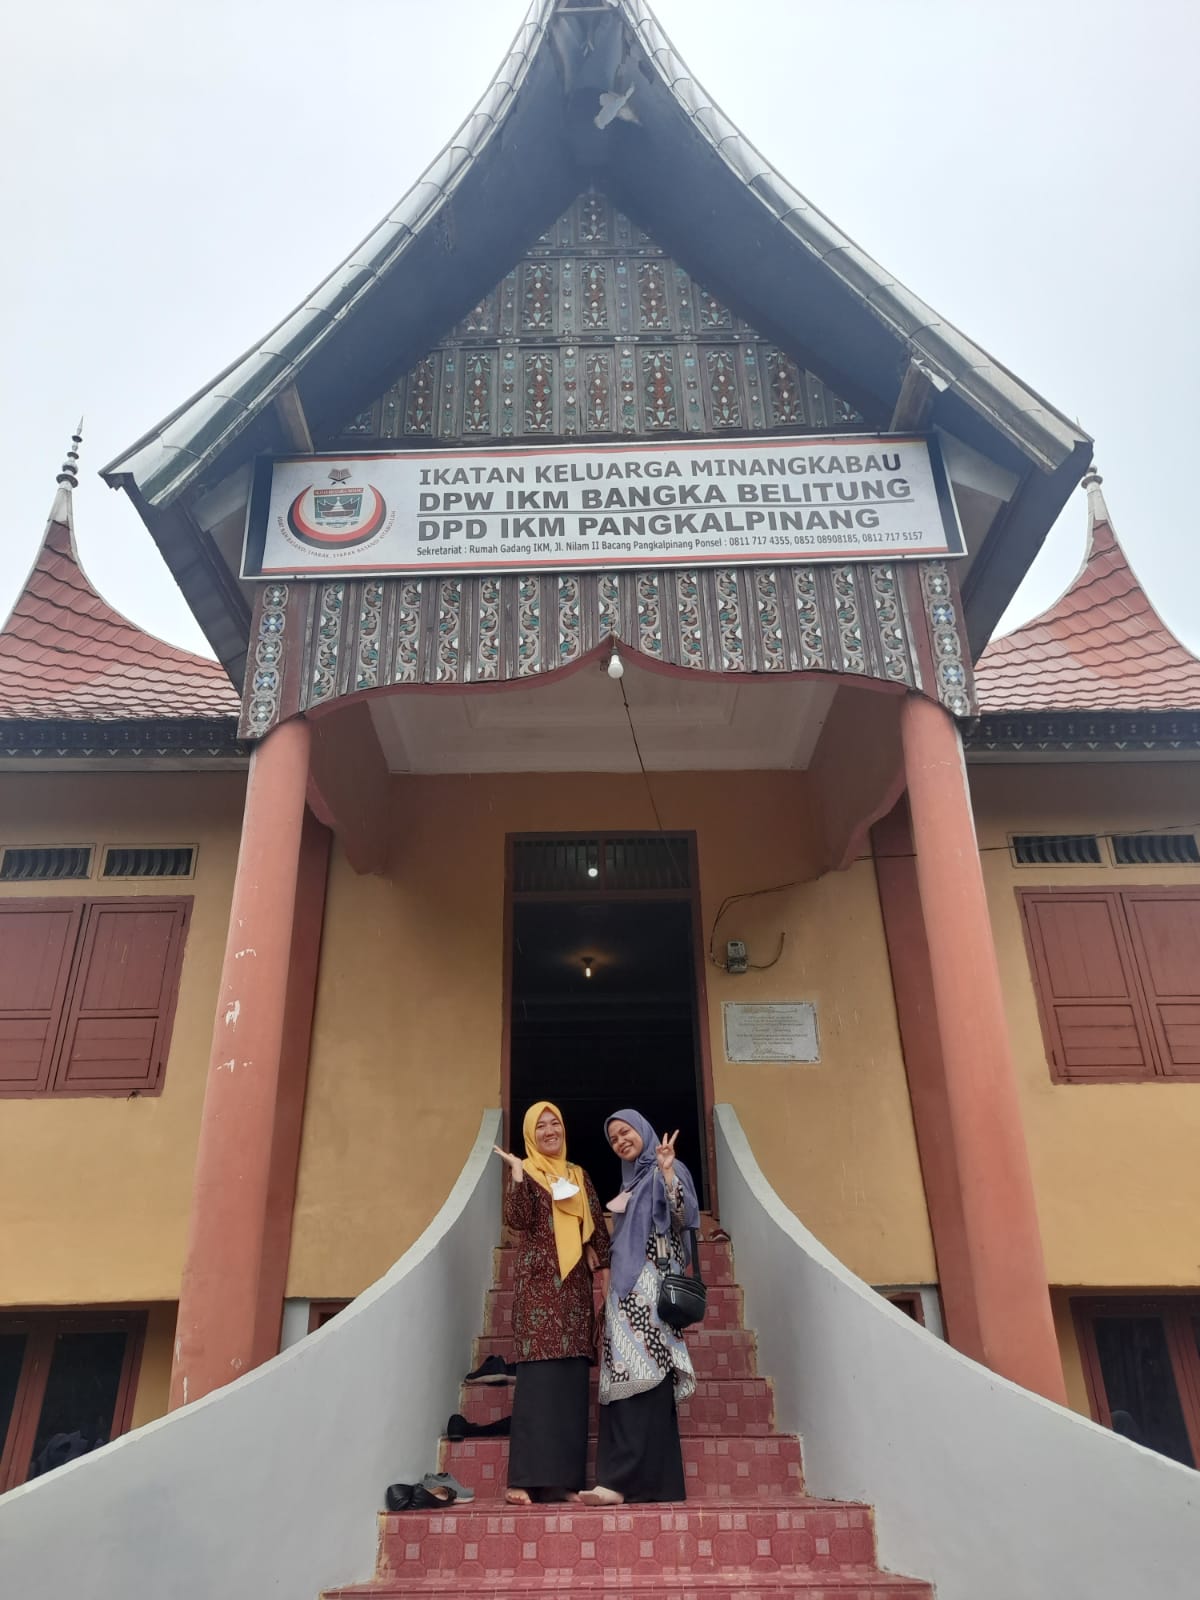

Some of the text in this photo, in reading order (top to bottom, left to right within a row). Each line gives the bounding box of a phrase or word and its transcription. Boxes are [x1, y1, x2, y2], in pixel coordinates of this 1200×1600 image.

[419, 453, 901, 486] IKATAN KELUARGA MINANGKABAU
[419, 478, 911, 512] DPW IKM BANGKA BELITUNG
[418, 508, 880, 541] DPD IKM PANGKALPINANG
[416, 545, 462, 556] Sekretariat
[469, 544, 498, 553] Rumah
[500, 544, 531, 555] Gadang
[533, 542, 552, 553] IKM,
[566, 541, 590, 551] Nilam
[591, 541, 600, 550] II
[601, 540, 631, 552] Bacang
[633, 538, 693, 551] Pangkalpinang
[695, 537, 722, 548] Ponsel
[729, 536, 750, 546] 0811
[752, 536, 767, 545] 717
[769, 535, 793, 547] 4355,
[794, 535, 815, 545] 0852
[862, 533, 882, 543] 0812
[885, 532, 901, 542] 717
[903, 531, 923, 541] 5157
